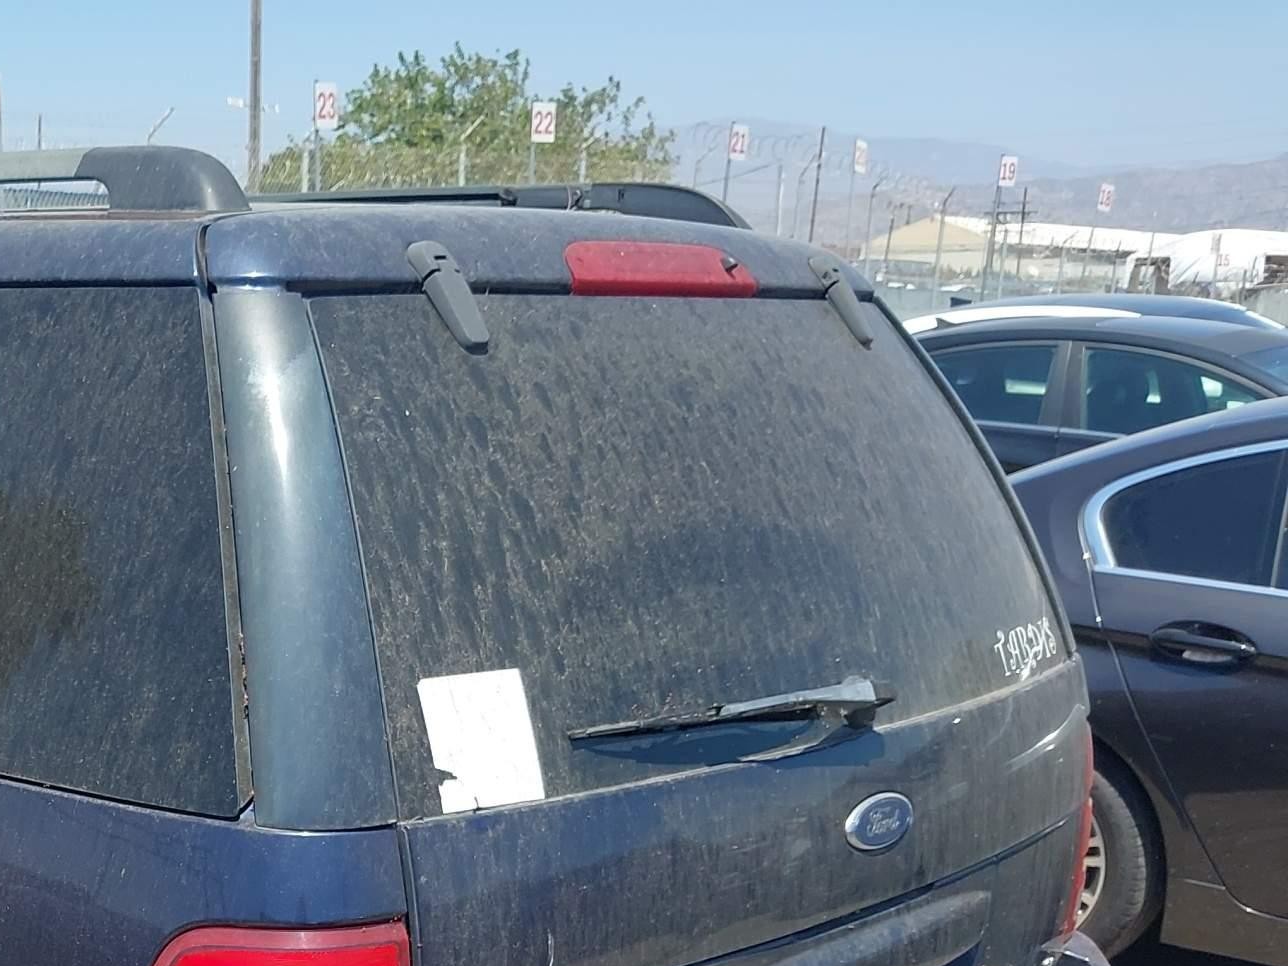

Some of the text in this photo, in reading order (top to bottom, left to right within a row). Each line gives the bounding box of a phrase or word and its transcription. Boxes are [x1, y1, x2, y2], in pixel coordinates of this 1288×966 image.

[317, 92, 336, 119] 23
[534, 111, 553, 134] 22
[731, 131, 746, 154] 21
[1001, 162, 1016, 181] 19
